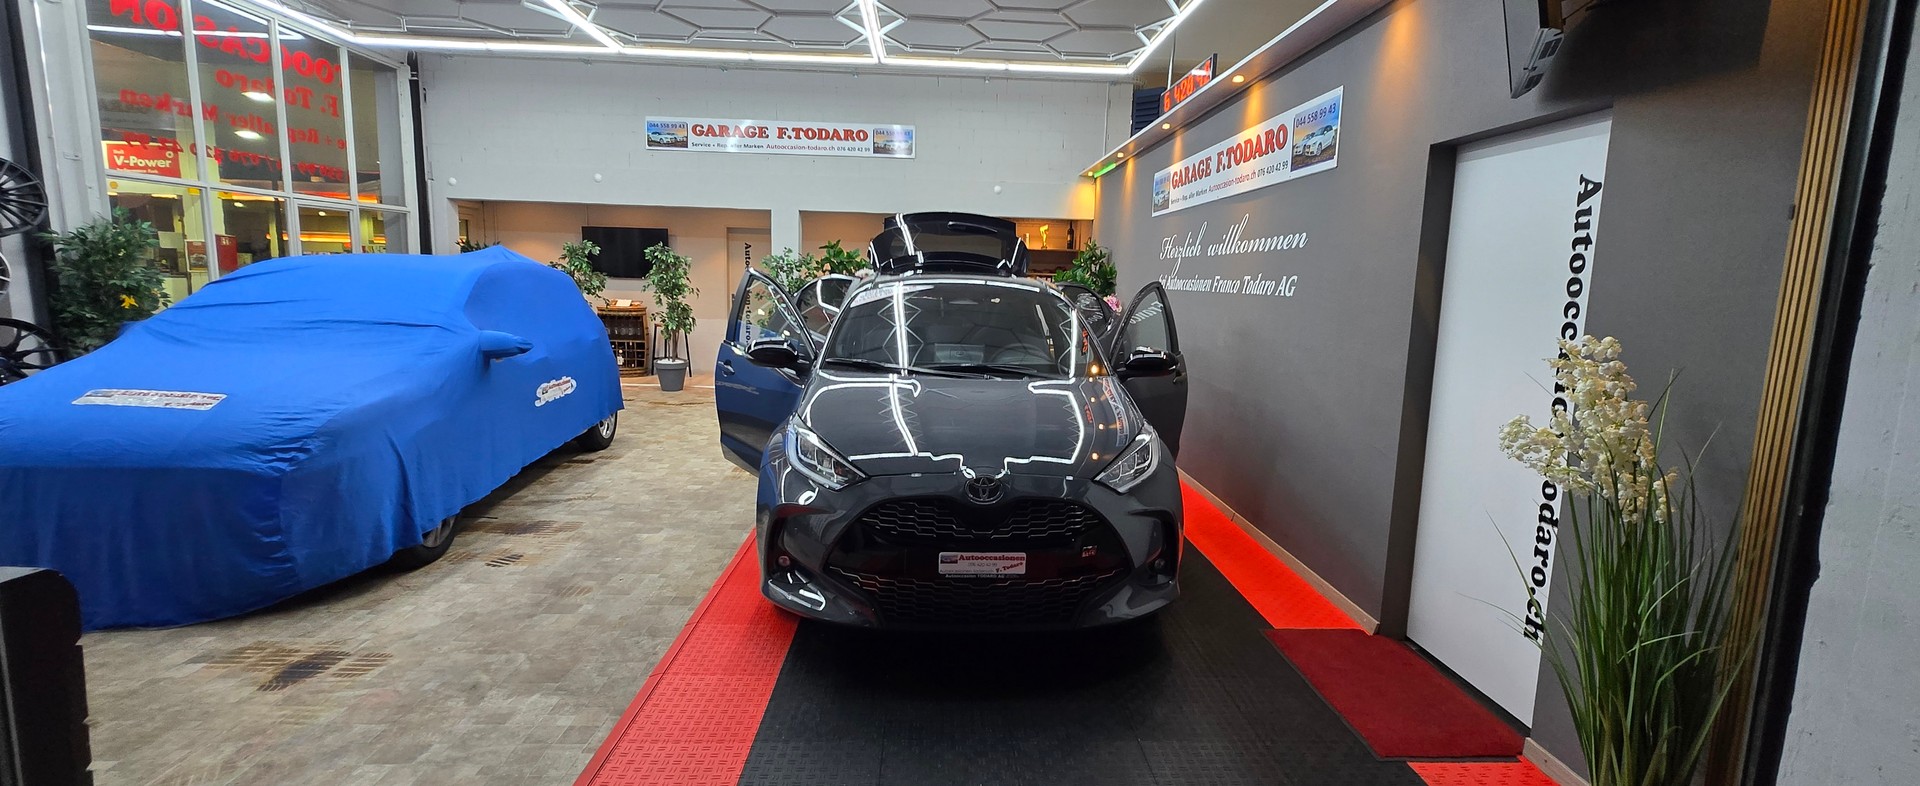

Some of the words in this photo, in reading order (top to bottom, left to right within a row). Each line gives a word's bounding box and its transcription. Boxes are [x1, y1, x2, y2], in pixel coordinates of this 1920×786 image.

[691, 124, 769, 139] GARAGE
[776, 126, 869, 142] F.TODARO
[113, 155, 172, 168] V-Power
[1171, 156, 1212, 190] GARAGE
[1216, 123, 1289, 174] F.TODARO
[1159, 222, 1208, 277] Herzlich
[1207, 213, 1309, 256] willkommen
[1211, 275, 1241, 293] Franco
[1241, 273, 1275, 296] Todaro
[1275, 275, 1298, 297] AG
